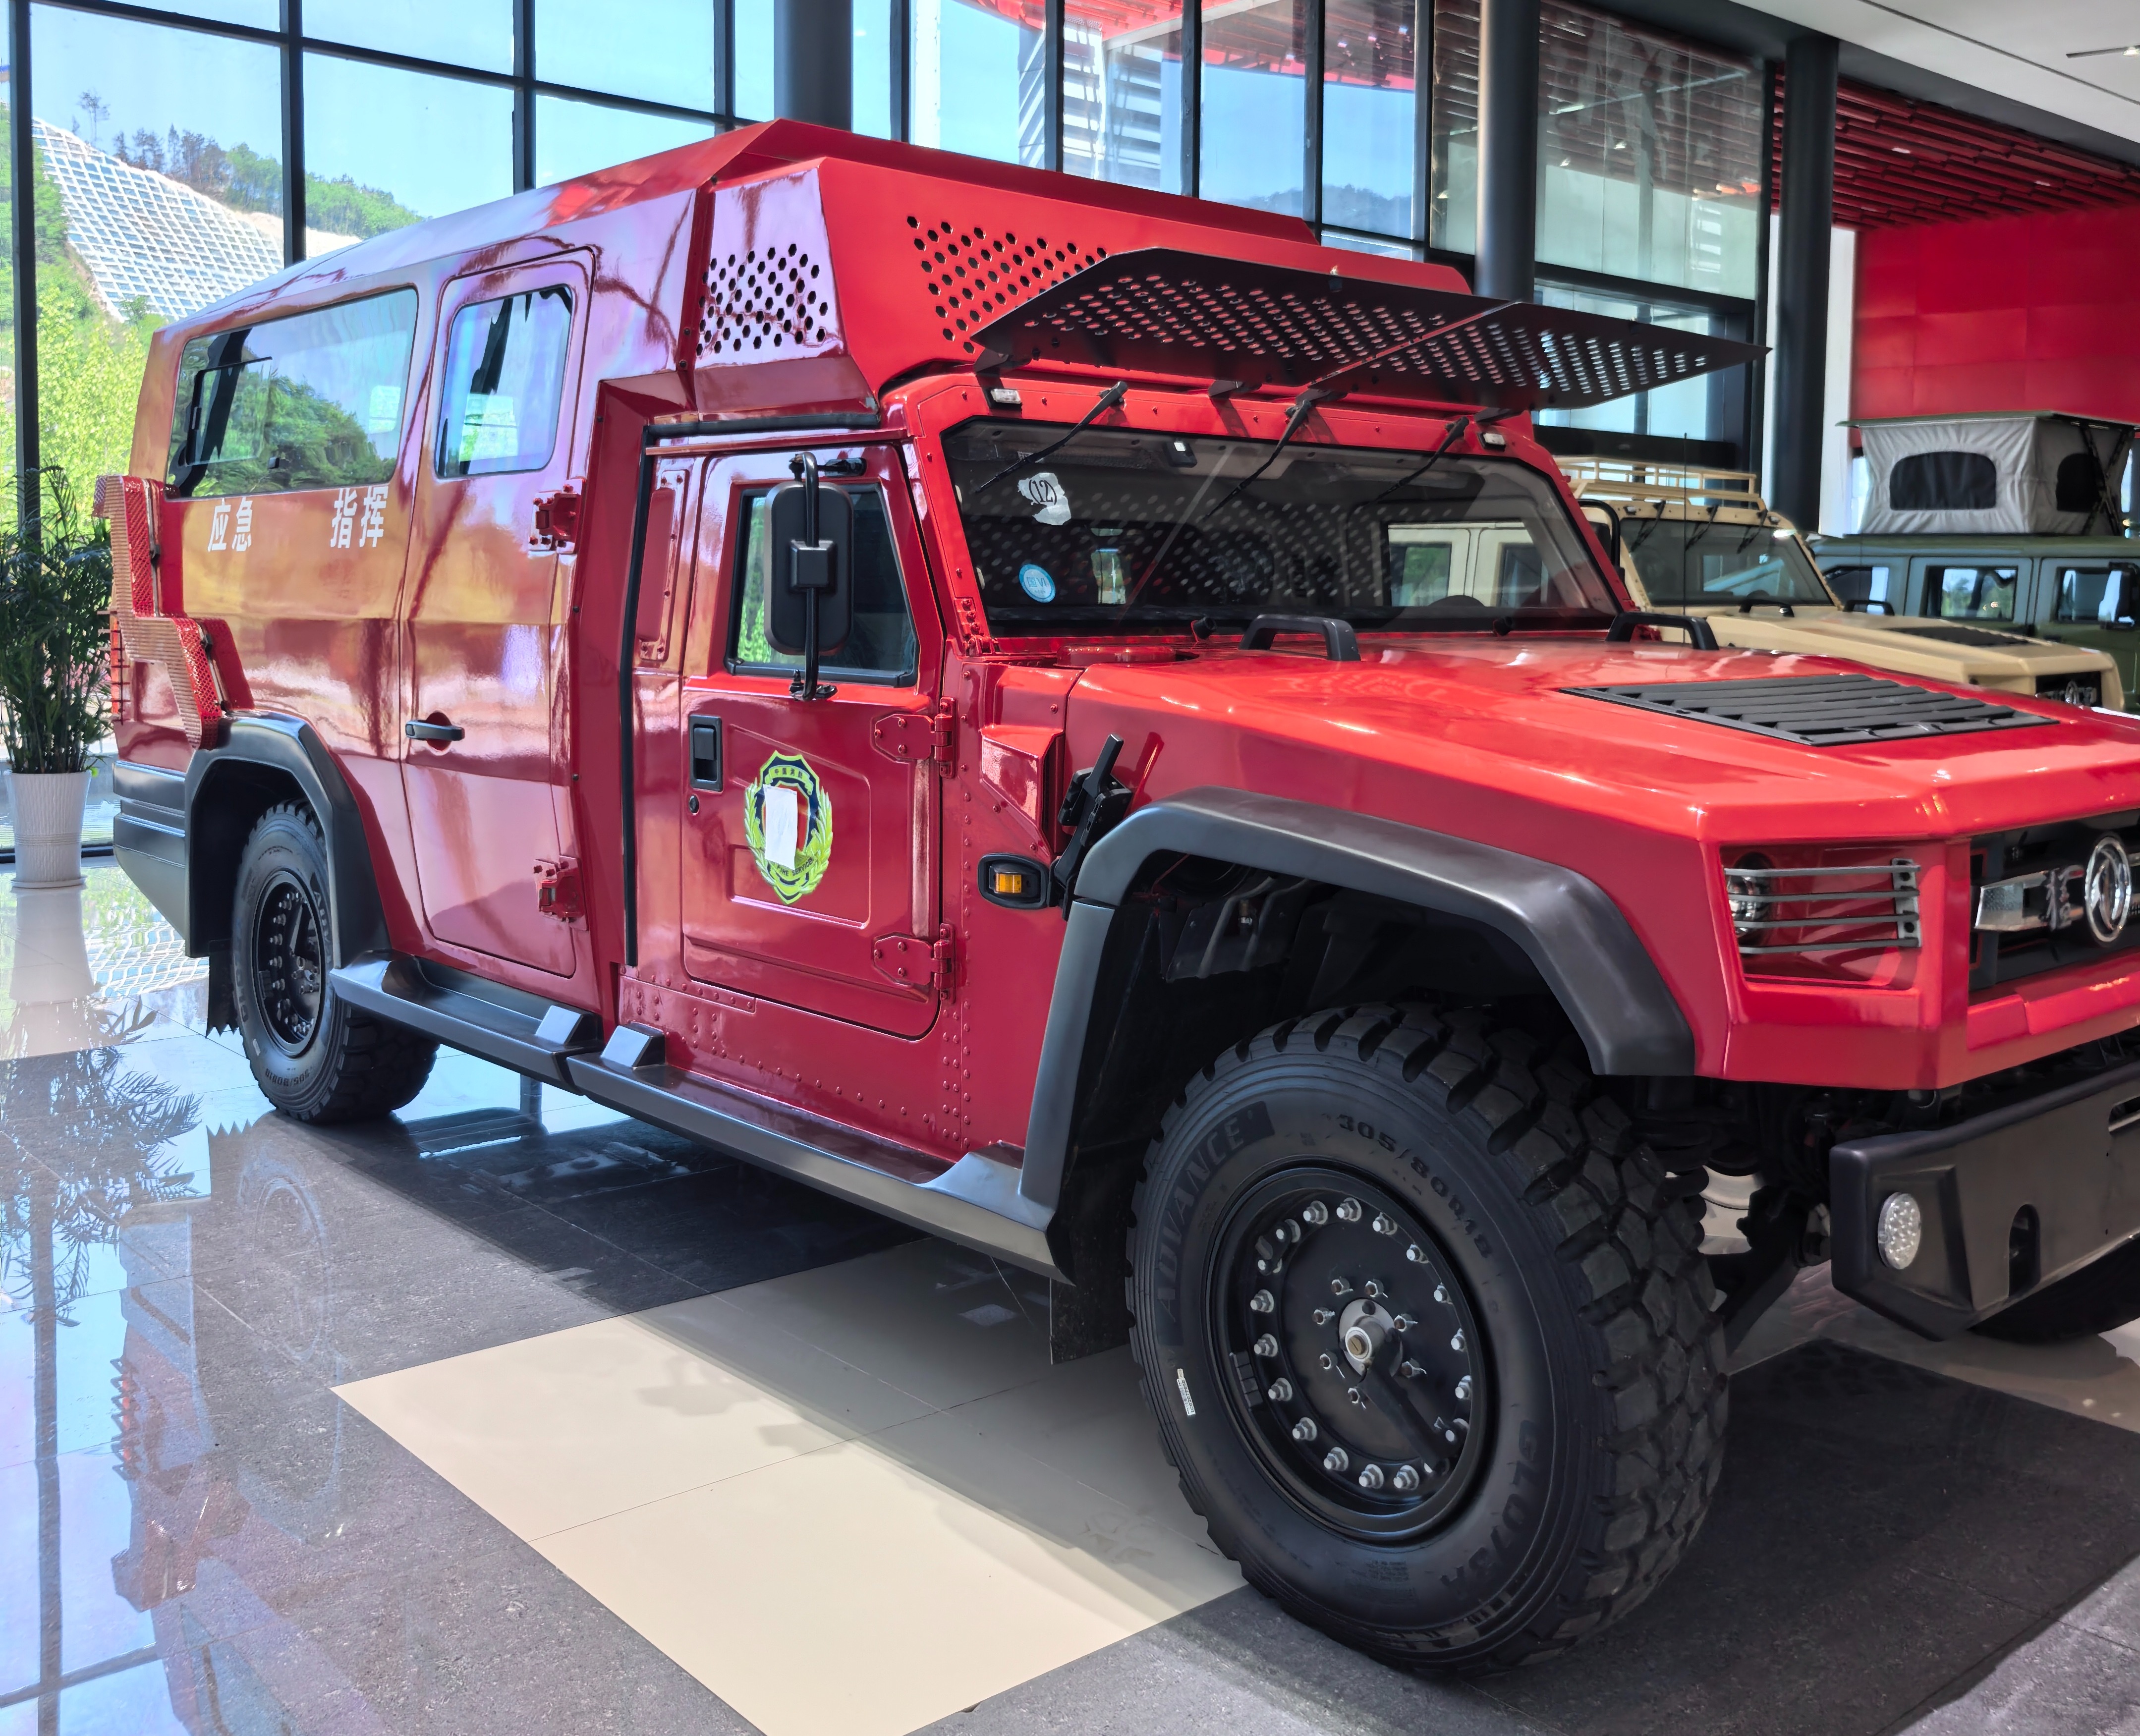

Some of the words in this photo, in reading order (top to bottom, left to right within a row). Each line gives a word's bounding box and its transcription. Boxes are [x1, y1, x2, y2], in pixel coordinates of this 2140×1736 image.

[207, 497, 253, 552] 应急
[330, 486, 389, 549] 指挥
[1028, 479, 1057, 505] (12)
[777, 864, 789, 877] FIRE
[1336, 1113, 1493, 1258] 305/80R18
[1157, 1116, 1245, 1323] ADVANCE
